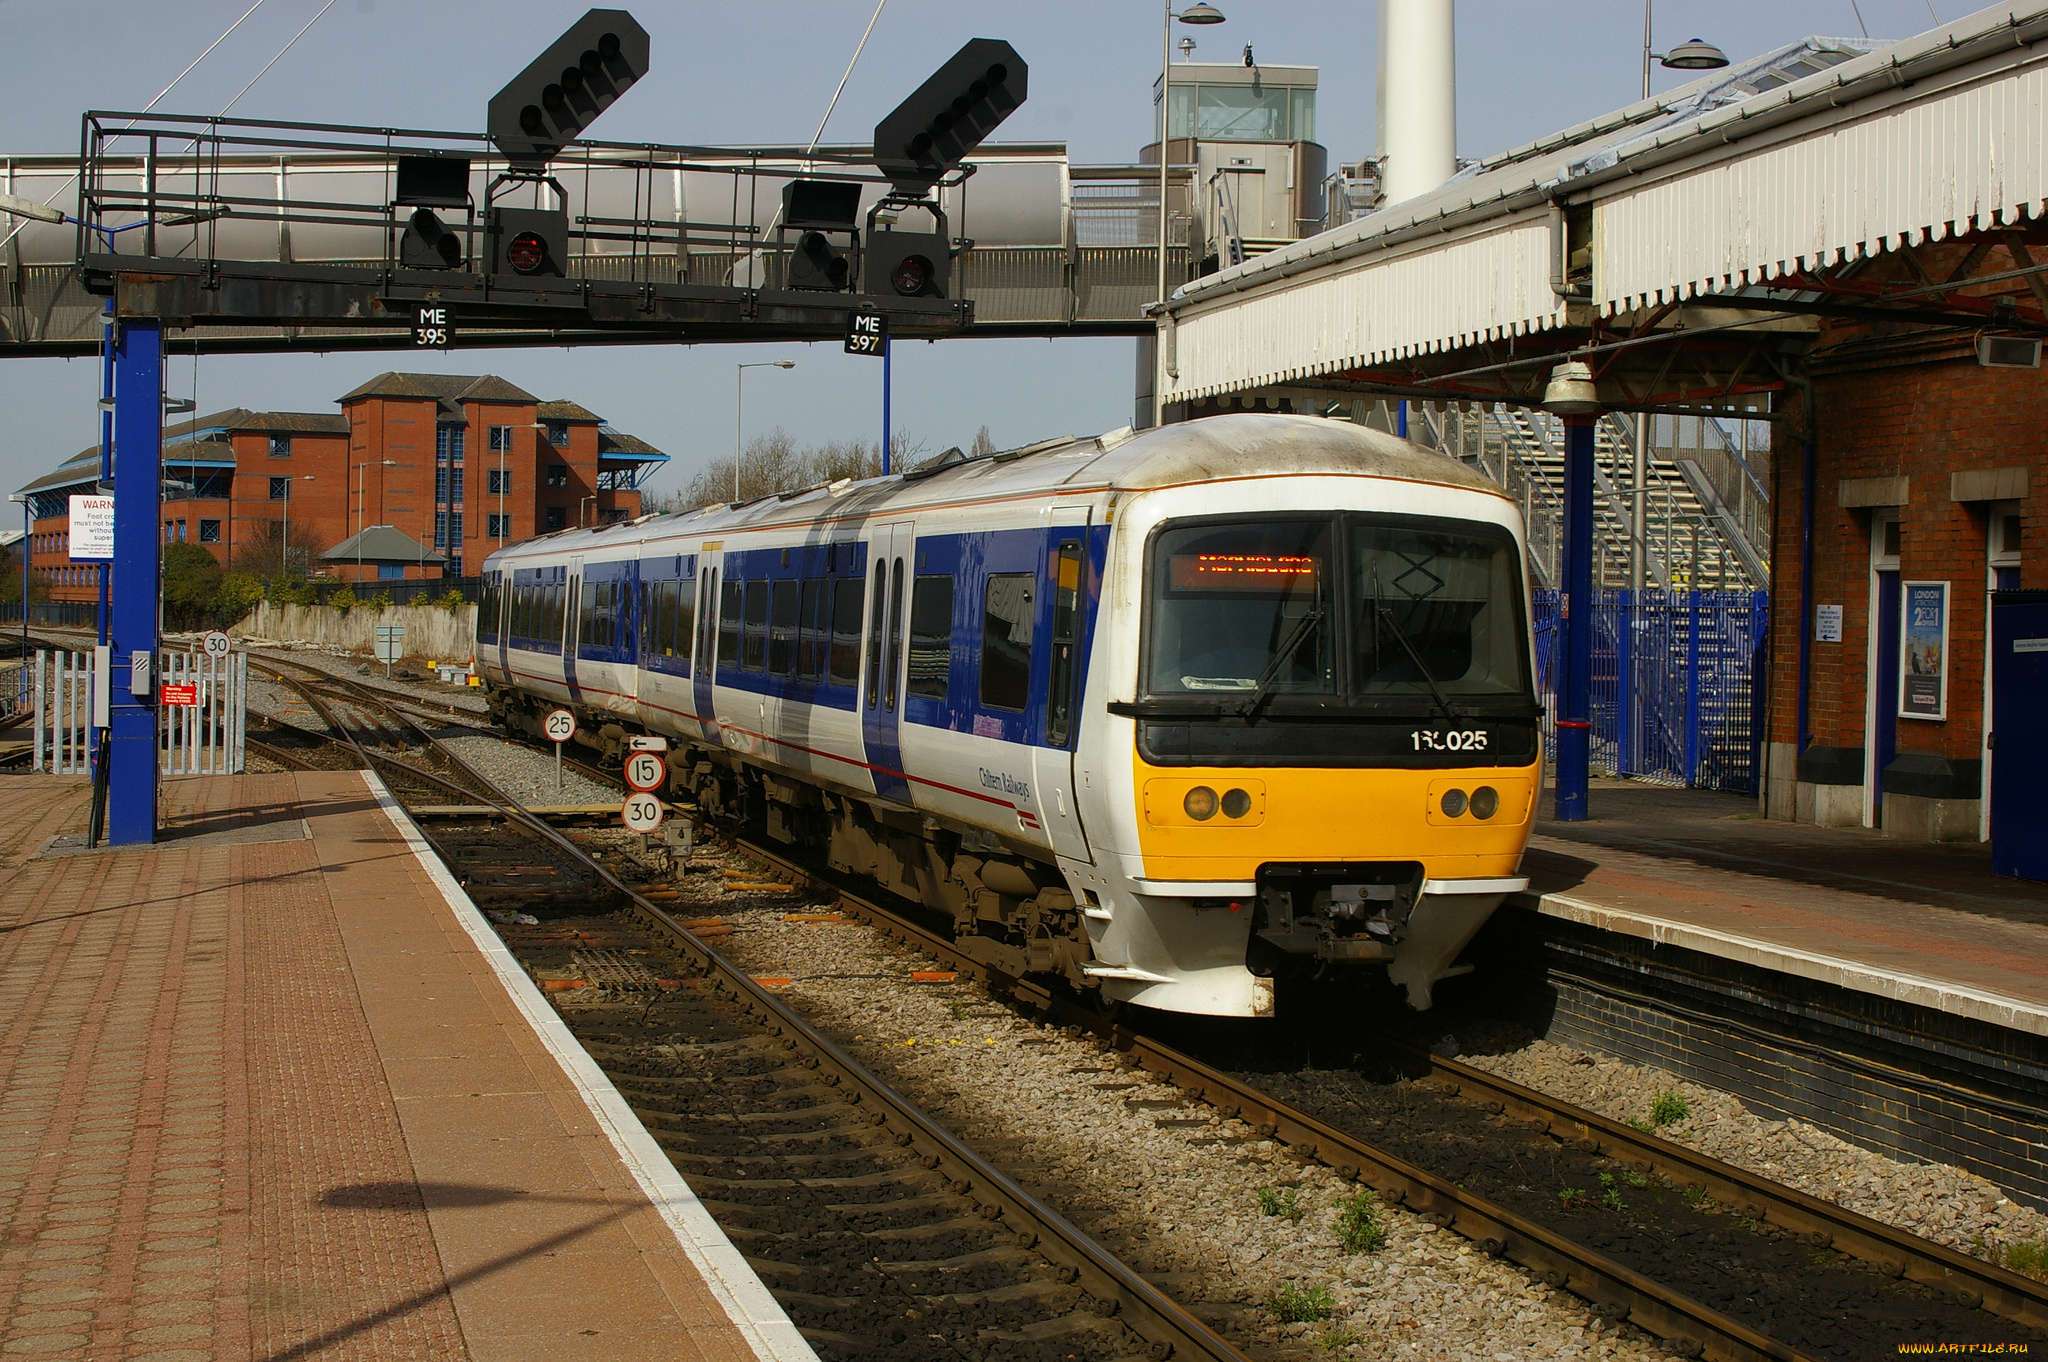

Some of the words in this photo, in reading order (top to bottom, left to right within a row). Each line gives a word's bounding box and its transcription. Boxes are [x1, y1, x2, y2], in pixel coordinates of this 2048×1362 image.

[420, 308, 446, 324] ME
[855, 315, 880, 332] ME
[416, 328, 447, 345] 395
[849, 334, 879, 351] 397
[1914, 590, 1939, 599] LONDON
[208, 638, 227, 652] 30
[549, 716, 570, 734] 25
[635, 760, 655, 782] 15
[979, 767, 1004, 791] Chiltern
[1002, 772, 1030, 802] Railways
[630, 802, 656, 821] 30
